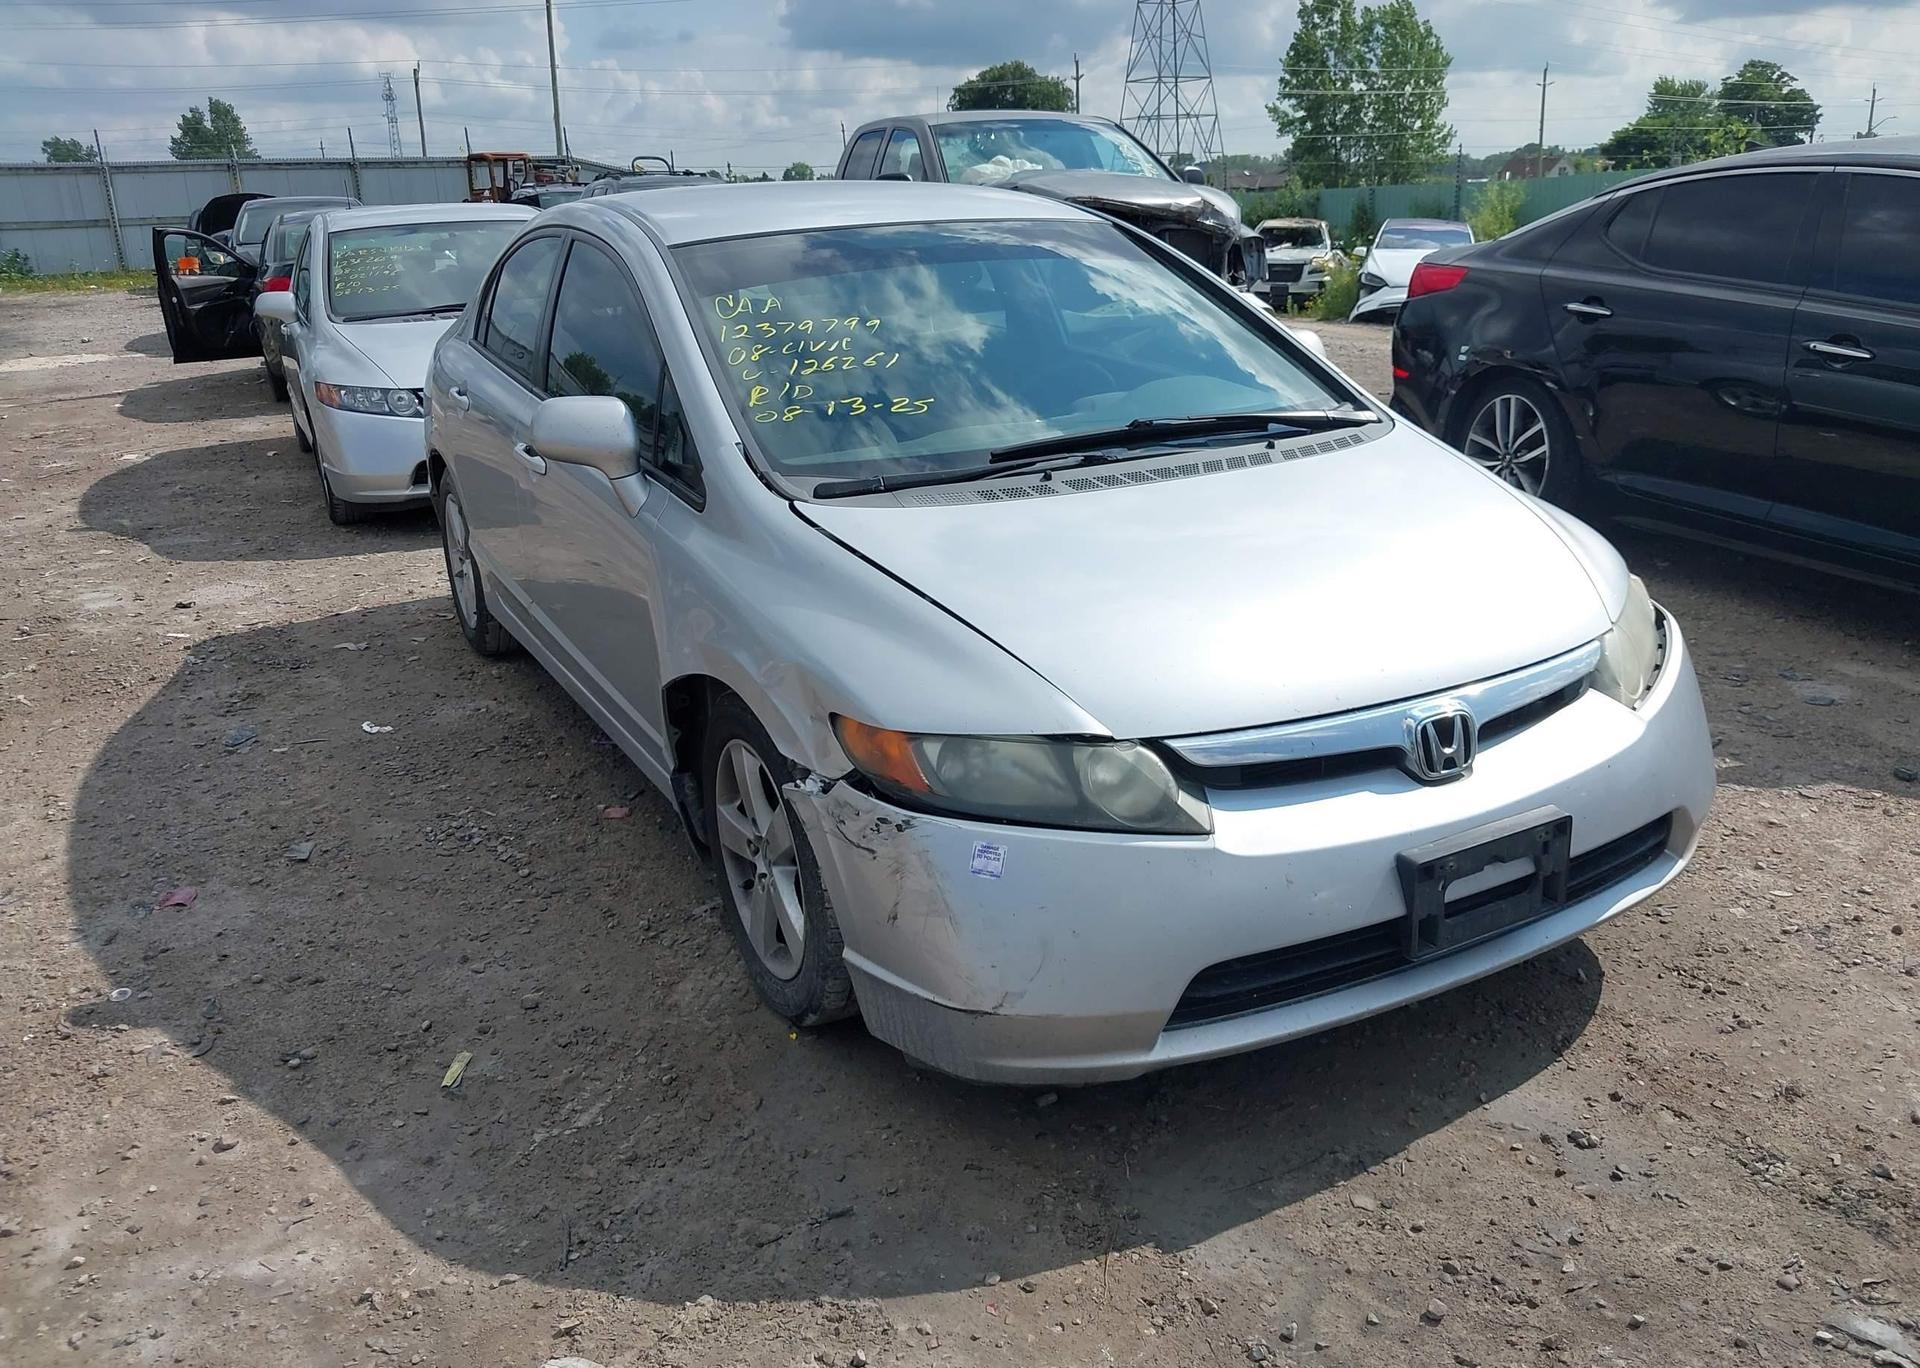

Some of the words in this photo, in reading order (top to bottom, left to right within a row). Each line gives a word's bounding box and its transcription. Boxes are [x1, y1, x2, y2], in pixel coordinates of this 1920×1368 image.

[720, 316, 881, 342] 12379799
[754, 396, 935, 423] 08-13-25
[977, 848, 1001, 857] REPORTED
